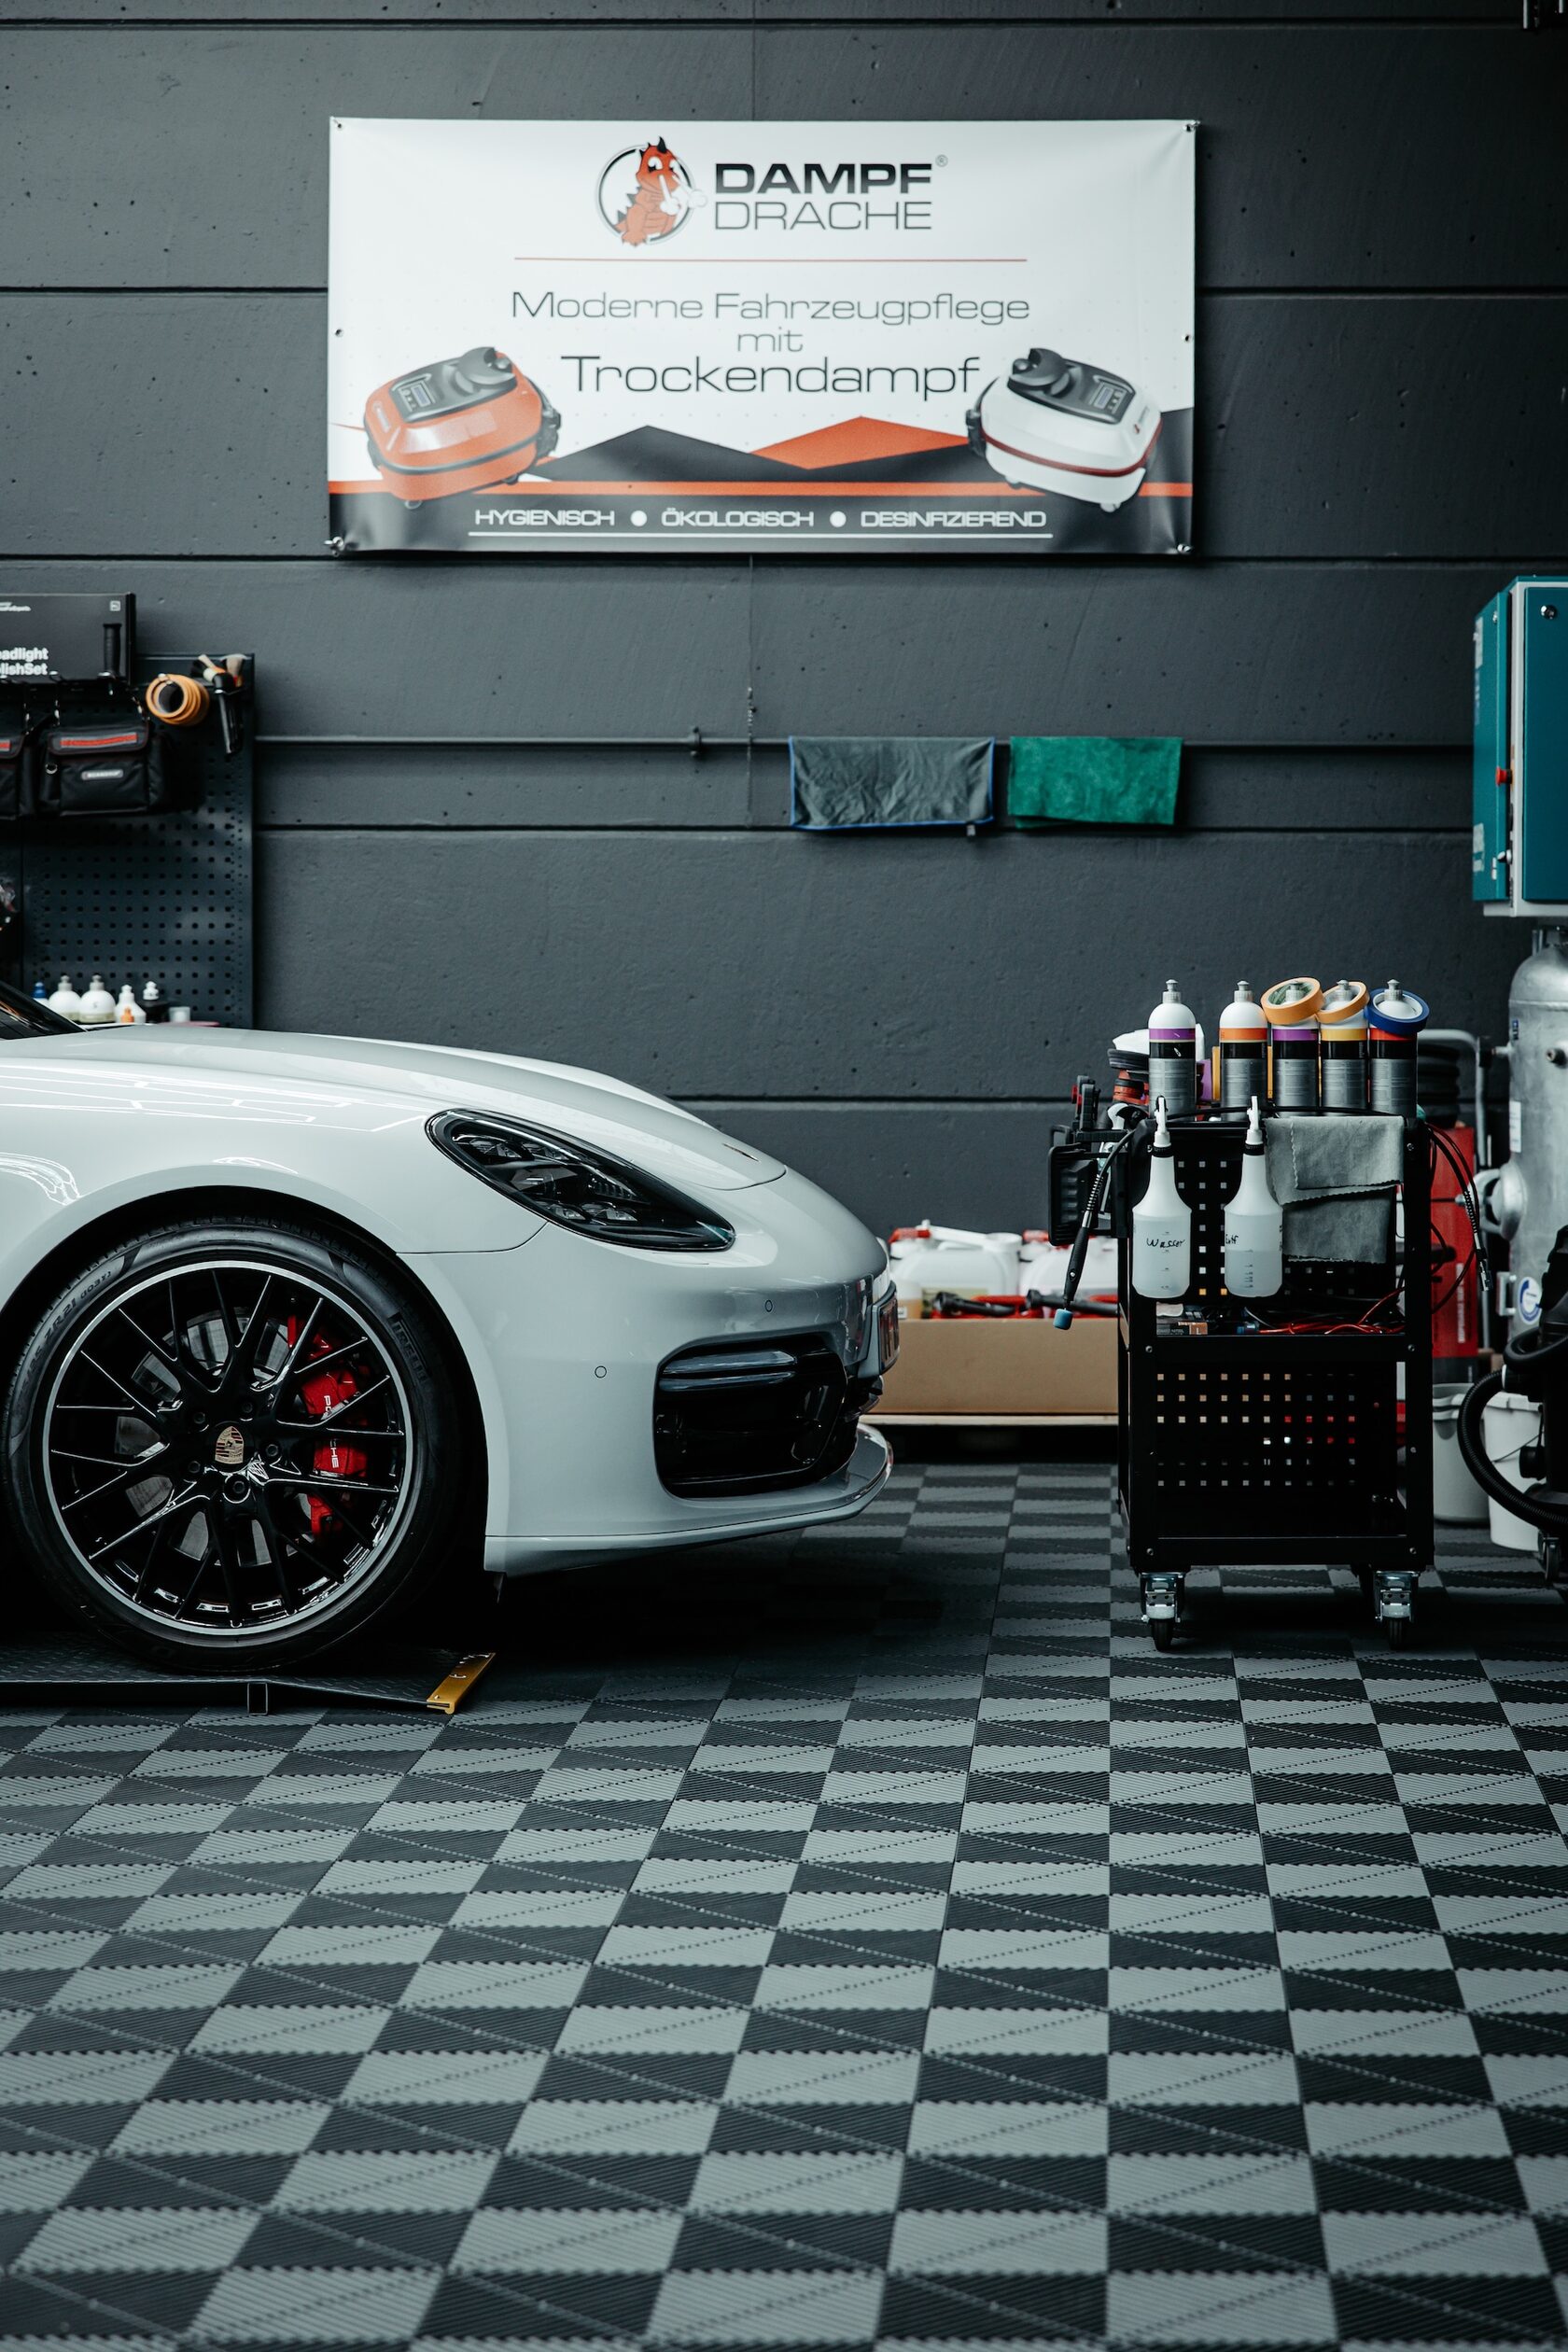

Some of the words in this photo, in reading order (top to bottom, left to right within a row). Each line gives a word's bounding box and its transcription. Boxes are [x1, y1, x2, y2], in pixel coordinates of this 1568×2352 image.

[716, 163, 932, 193] DAMPF
[715, 202, 932, 231] DRACHE
[512, 291, 703, 319] Moderne
[715, 292, 1030, 326] Fahrzeugpflege
[736, 327, 804, 353] mit
[561, 356, 980, 402] Trockendampf
[474, 510, 615, 526] HYGIENISCH
[661, 507, 814, 527] ÖKOLOGISCH
[861, 511, 1047, 528] DESINFIZIEREND
[0, 647, 49, 662] adlight
[0, 663, 48, 676] lishSet
[324, 1395, 340, 1469] POCHE
